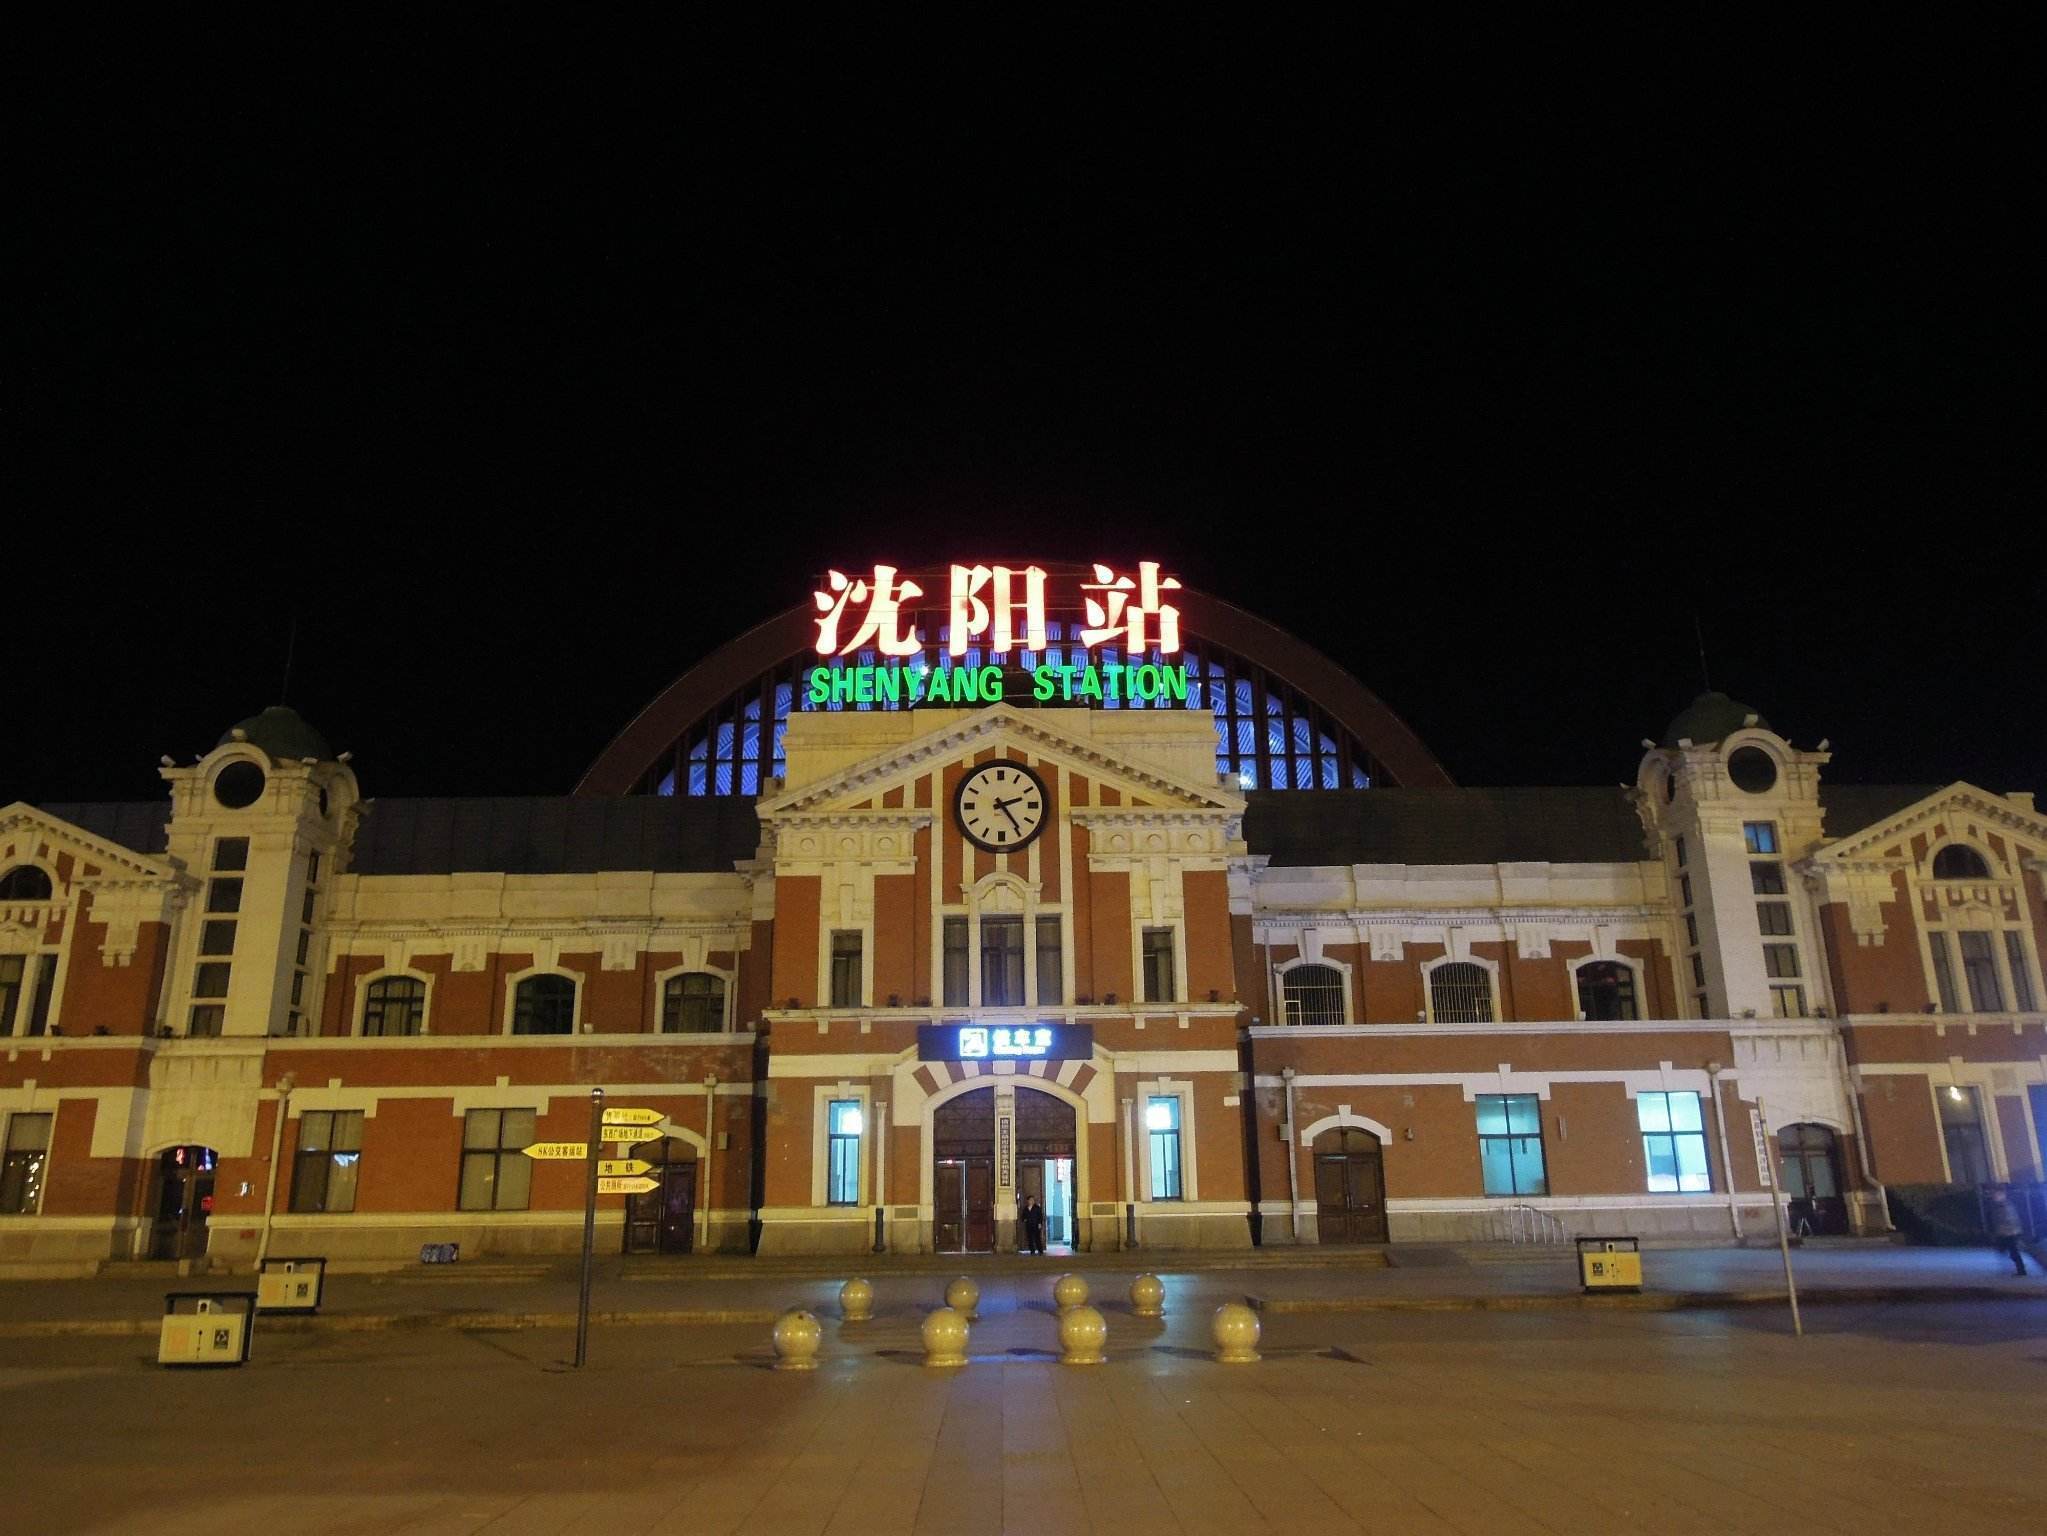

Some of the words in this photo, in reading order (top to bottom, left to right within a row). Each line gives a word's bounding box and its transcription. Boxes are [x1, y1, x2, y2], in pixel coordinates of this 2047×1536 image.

[814, 561, 1182, 656] 沈阳站
[809, 666, 1003, 702] SHENYANG
[1033, 664, 1187, 701] STATION
